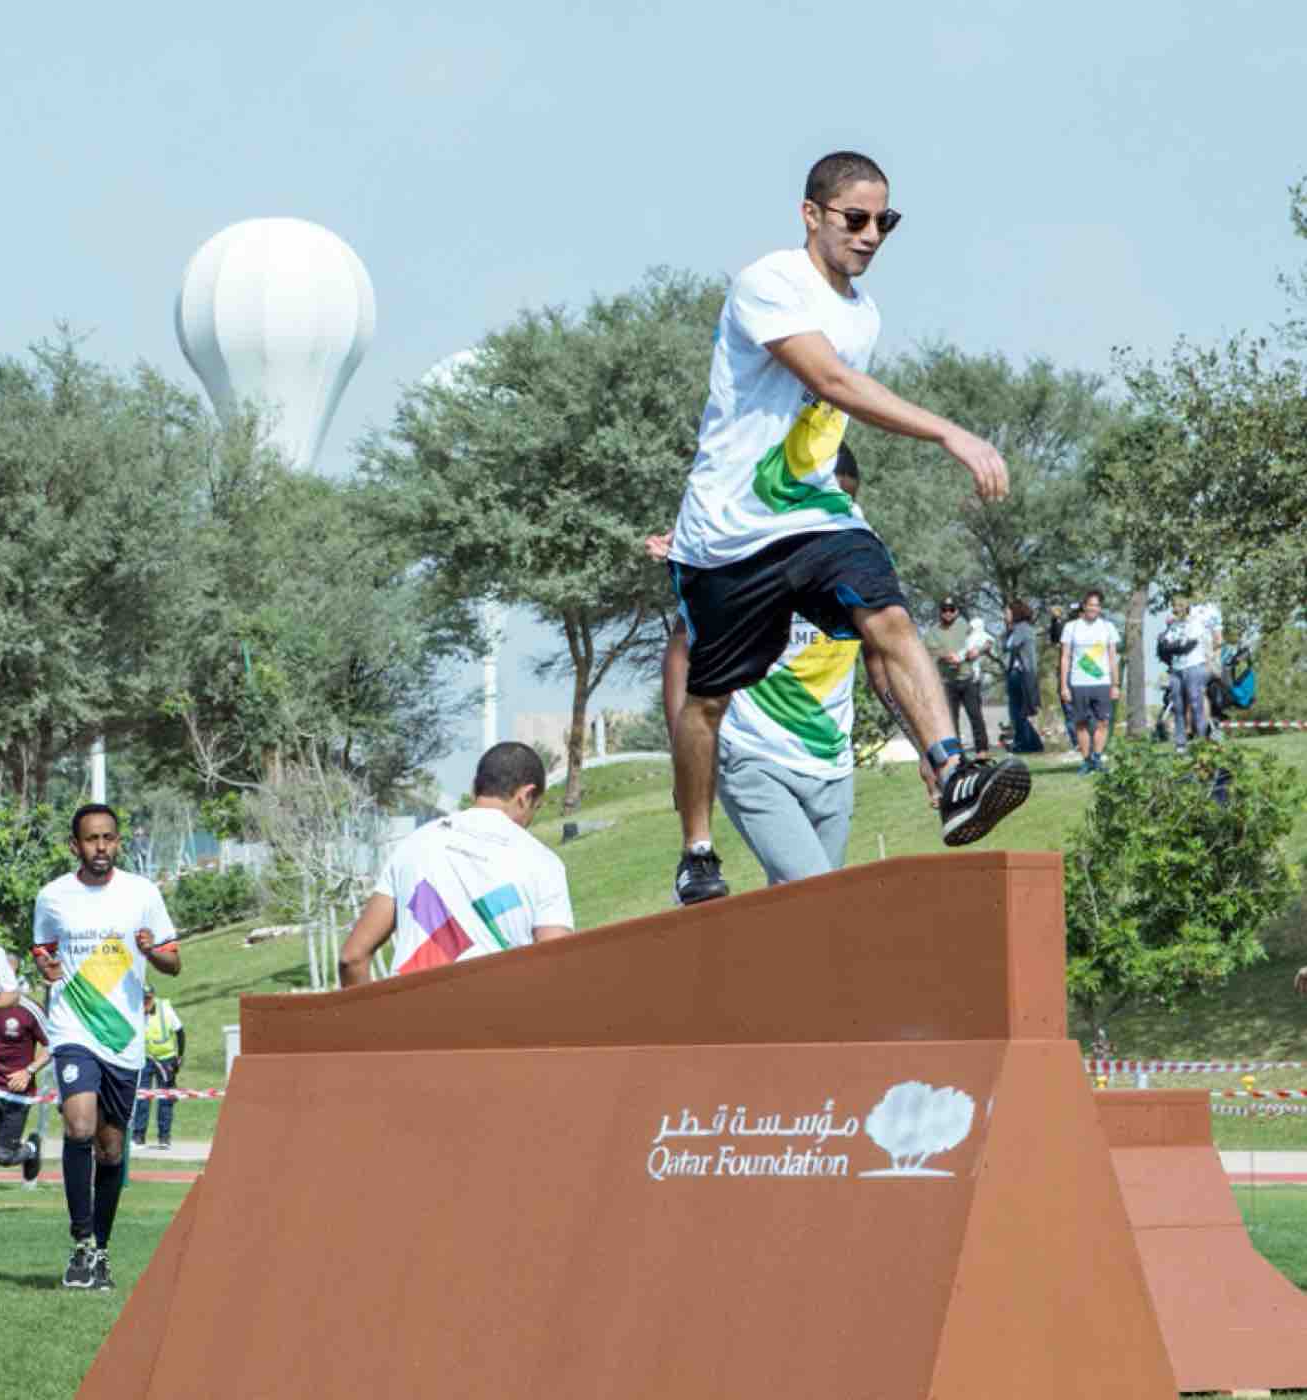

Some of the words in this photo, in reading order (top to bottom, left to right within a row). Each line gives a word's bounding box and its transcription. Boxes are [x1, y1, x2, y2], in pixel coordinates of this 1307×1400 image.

[653, 1104, 728, 1144] قطر
[728, 1098, 858, 1144] مؤسسة
[647, 1144, 712, 1180] Qatar
[713, 1145, 849, 1176] Foundation
